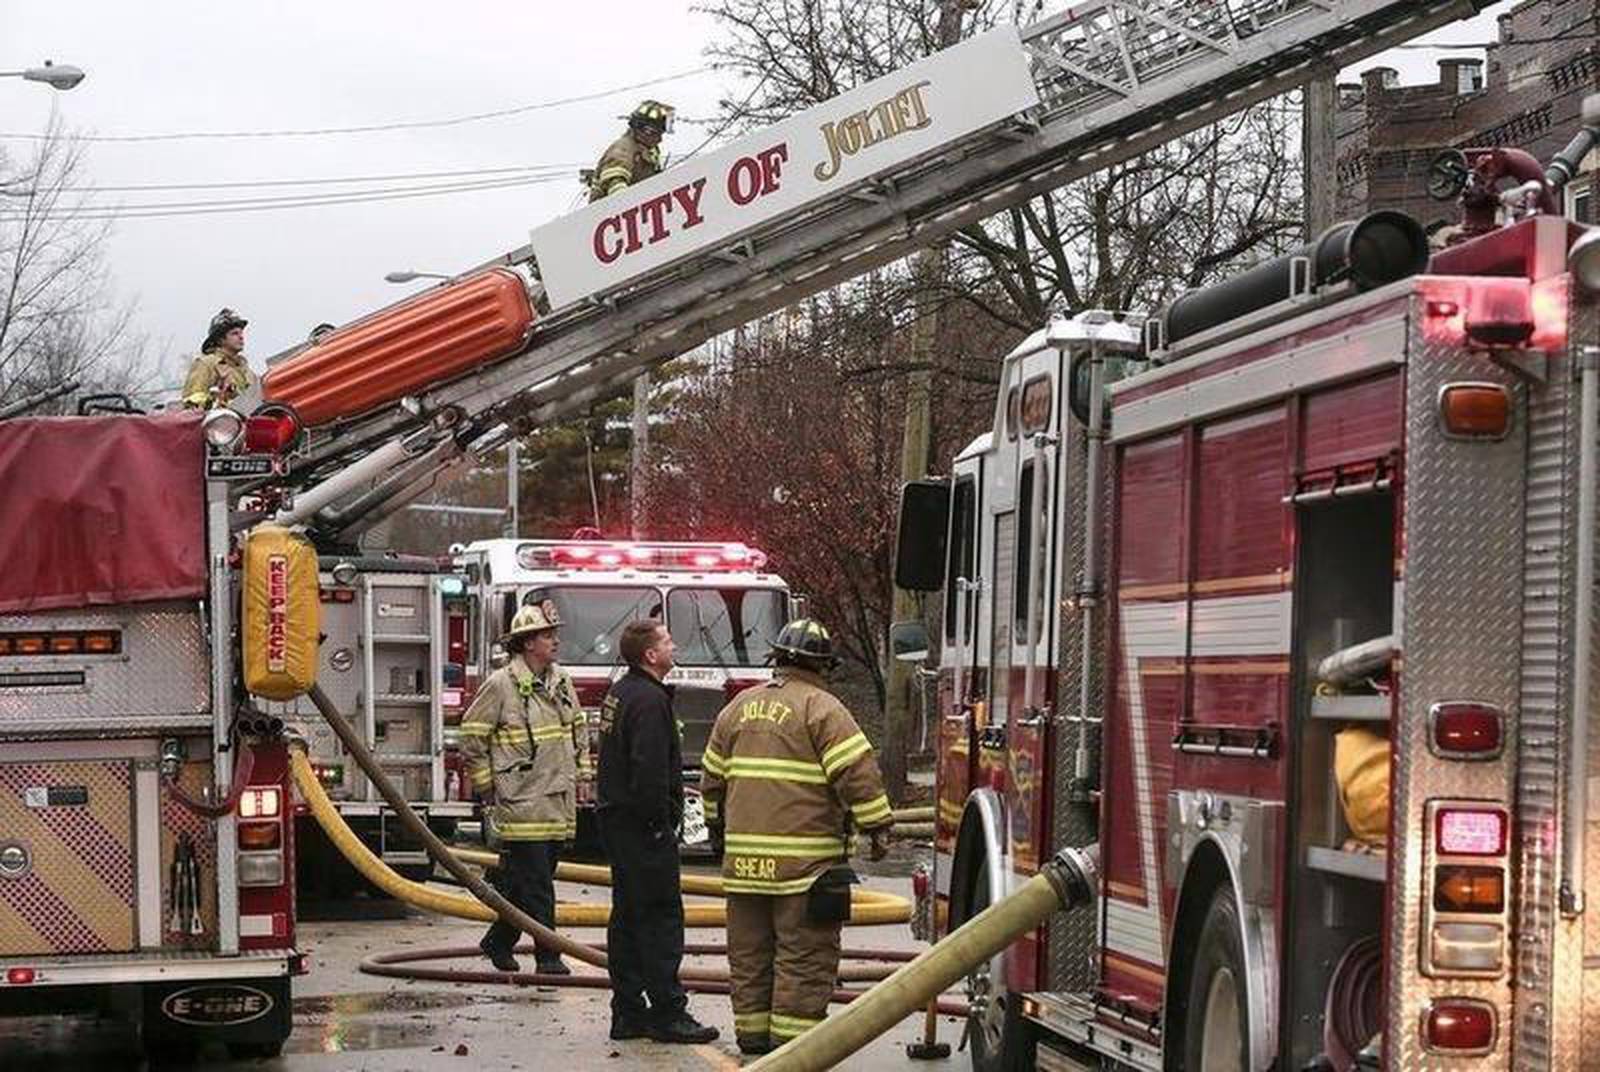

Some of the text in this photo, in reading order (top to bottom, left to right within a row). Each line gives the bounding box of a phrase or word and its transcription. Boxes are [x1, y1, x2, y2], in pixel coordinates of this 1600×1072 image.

[593, 80, 932, 264] CITY OF JOLIET
[269, 560, 285, 660] KEEP BACK
[740, 700, 792, 725] JOLIET
[734, 857, 776, 880] SHEAR
[173, 996, 262, 1015] E-ONE
